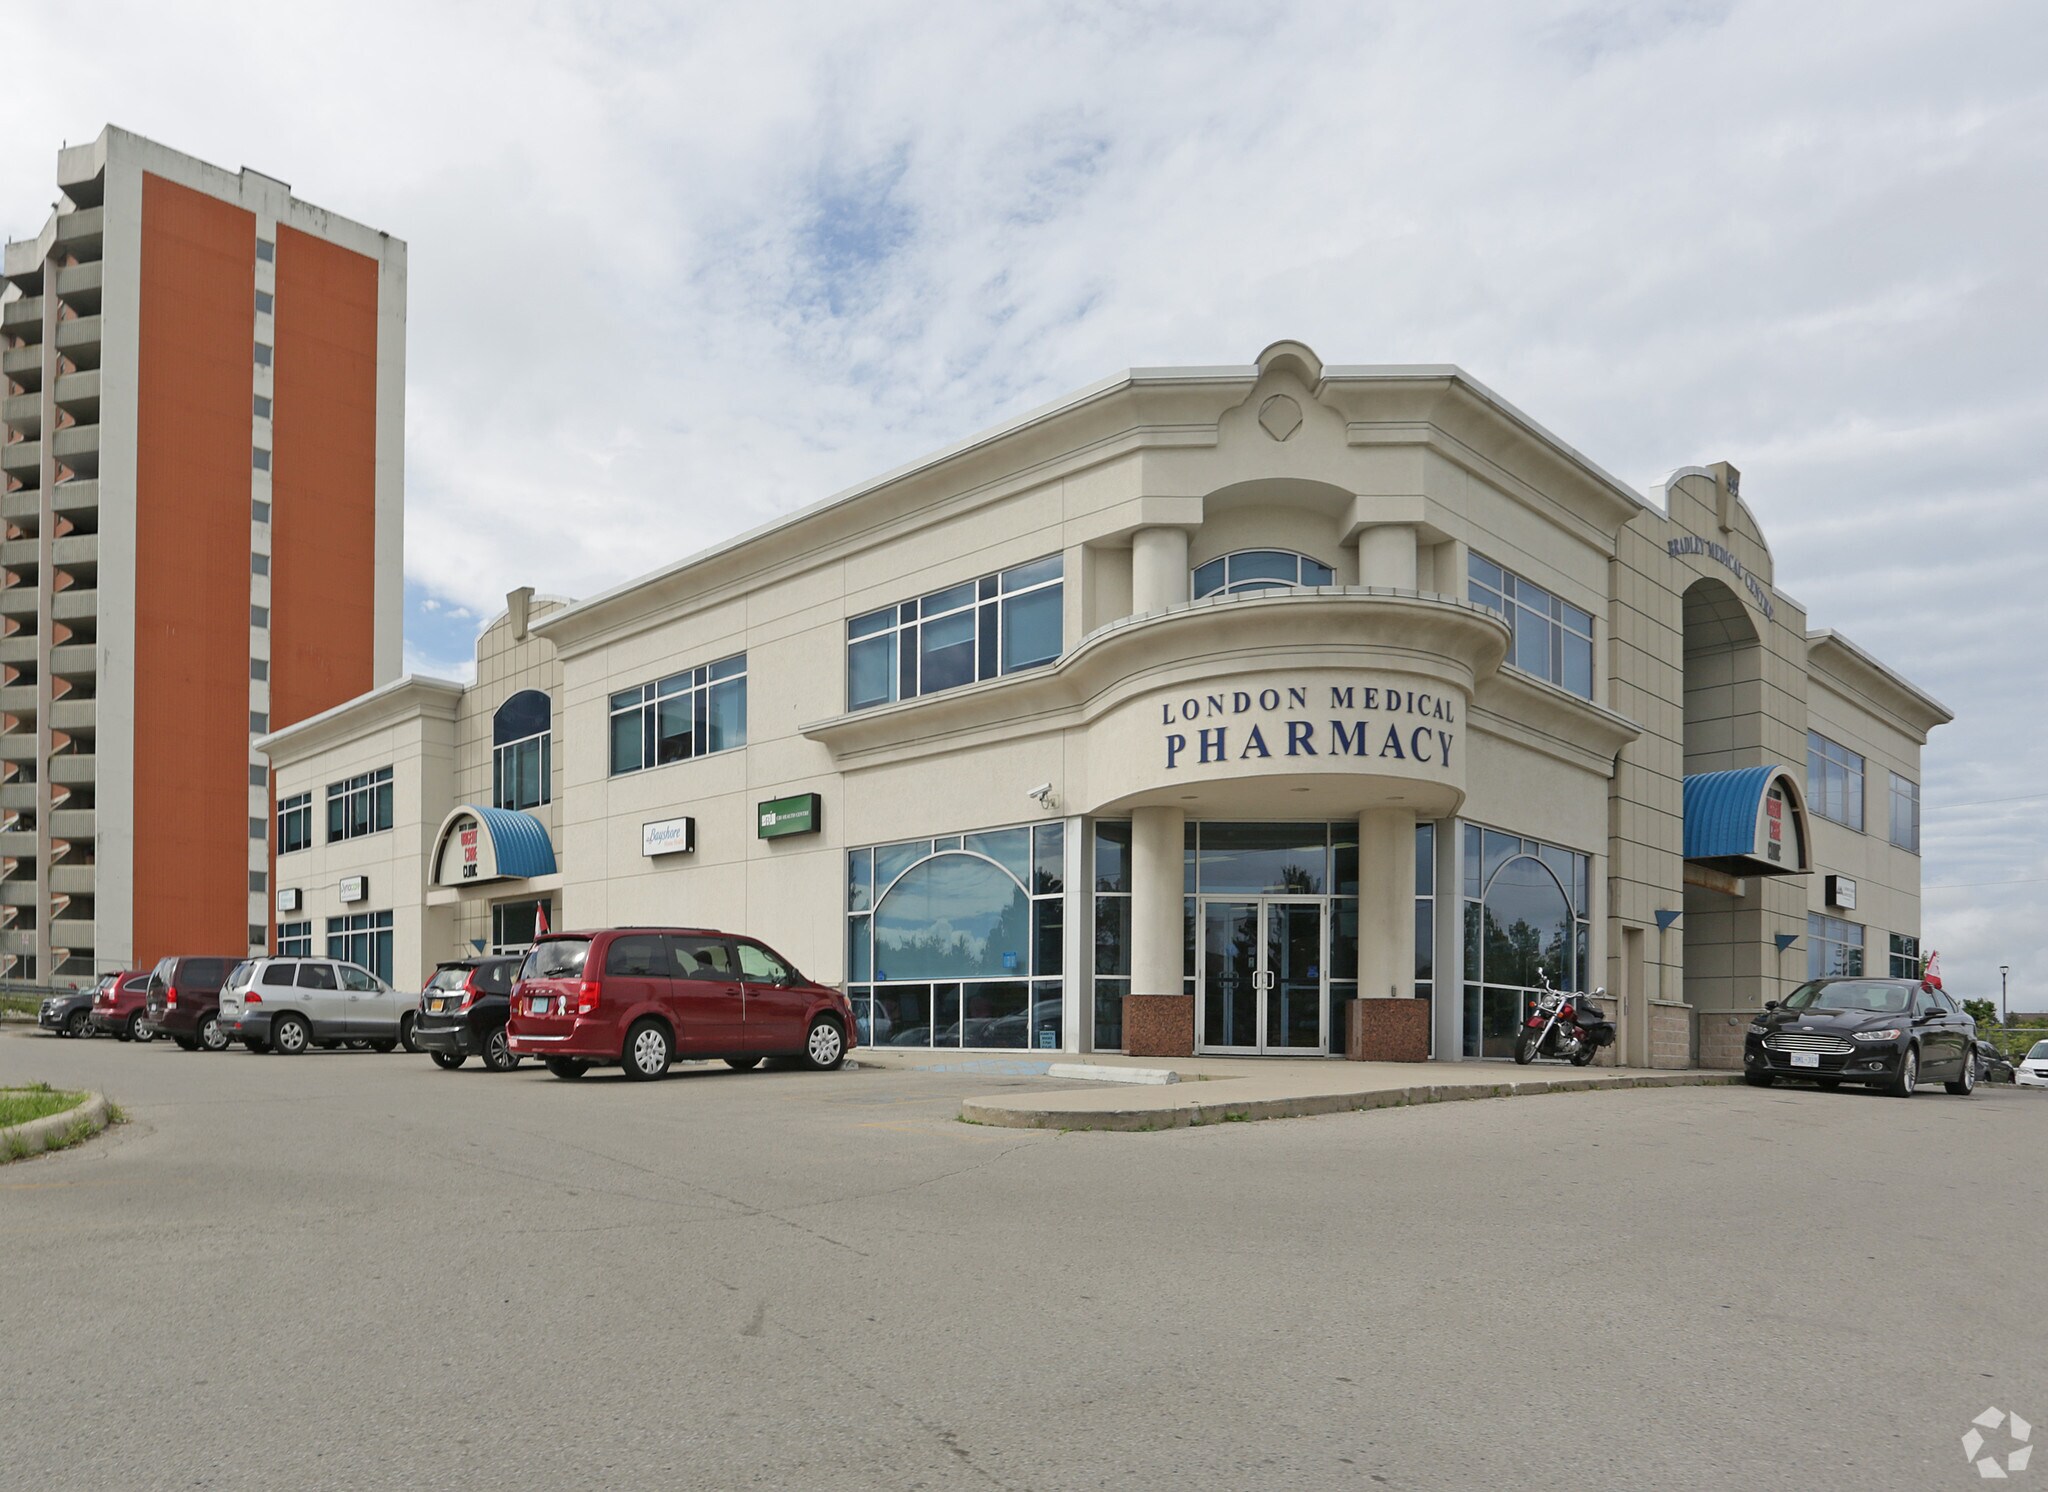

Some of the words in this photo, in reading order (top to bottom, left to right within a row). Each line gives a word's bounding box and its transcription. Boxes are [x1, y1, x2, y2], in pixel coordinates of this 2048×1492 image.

[1667, 536, 1704, 558] BRADLEY
[1707, 541, 1743, 580] MEDICAL
[1162, 687, 1307, 725] LONDON
[1330, 687, 1455, 723] MEDICAL
[1164, 720, 1454, 769] PHARMACY
[649, 825, 680, 845] Bayshore
[463, 864, 477, 878] CLINIC
